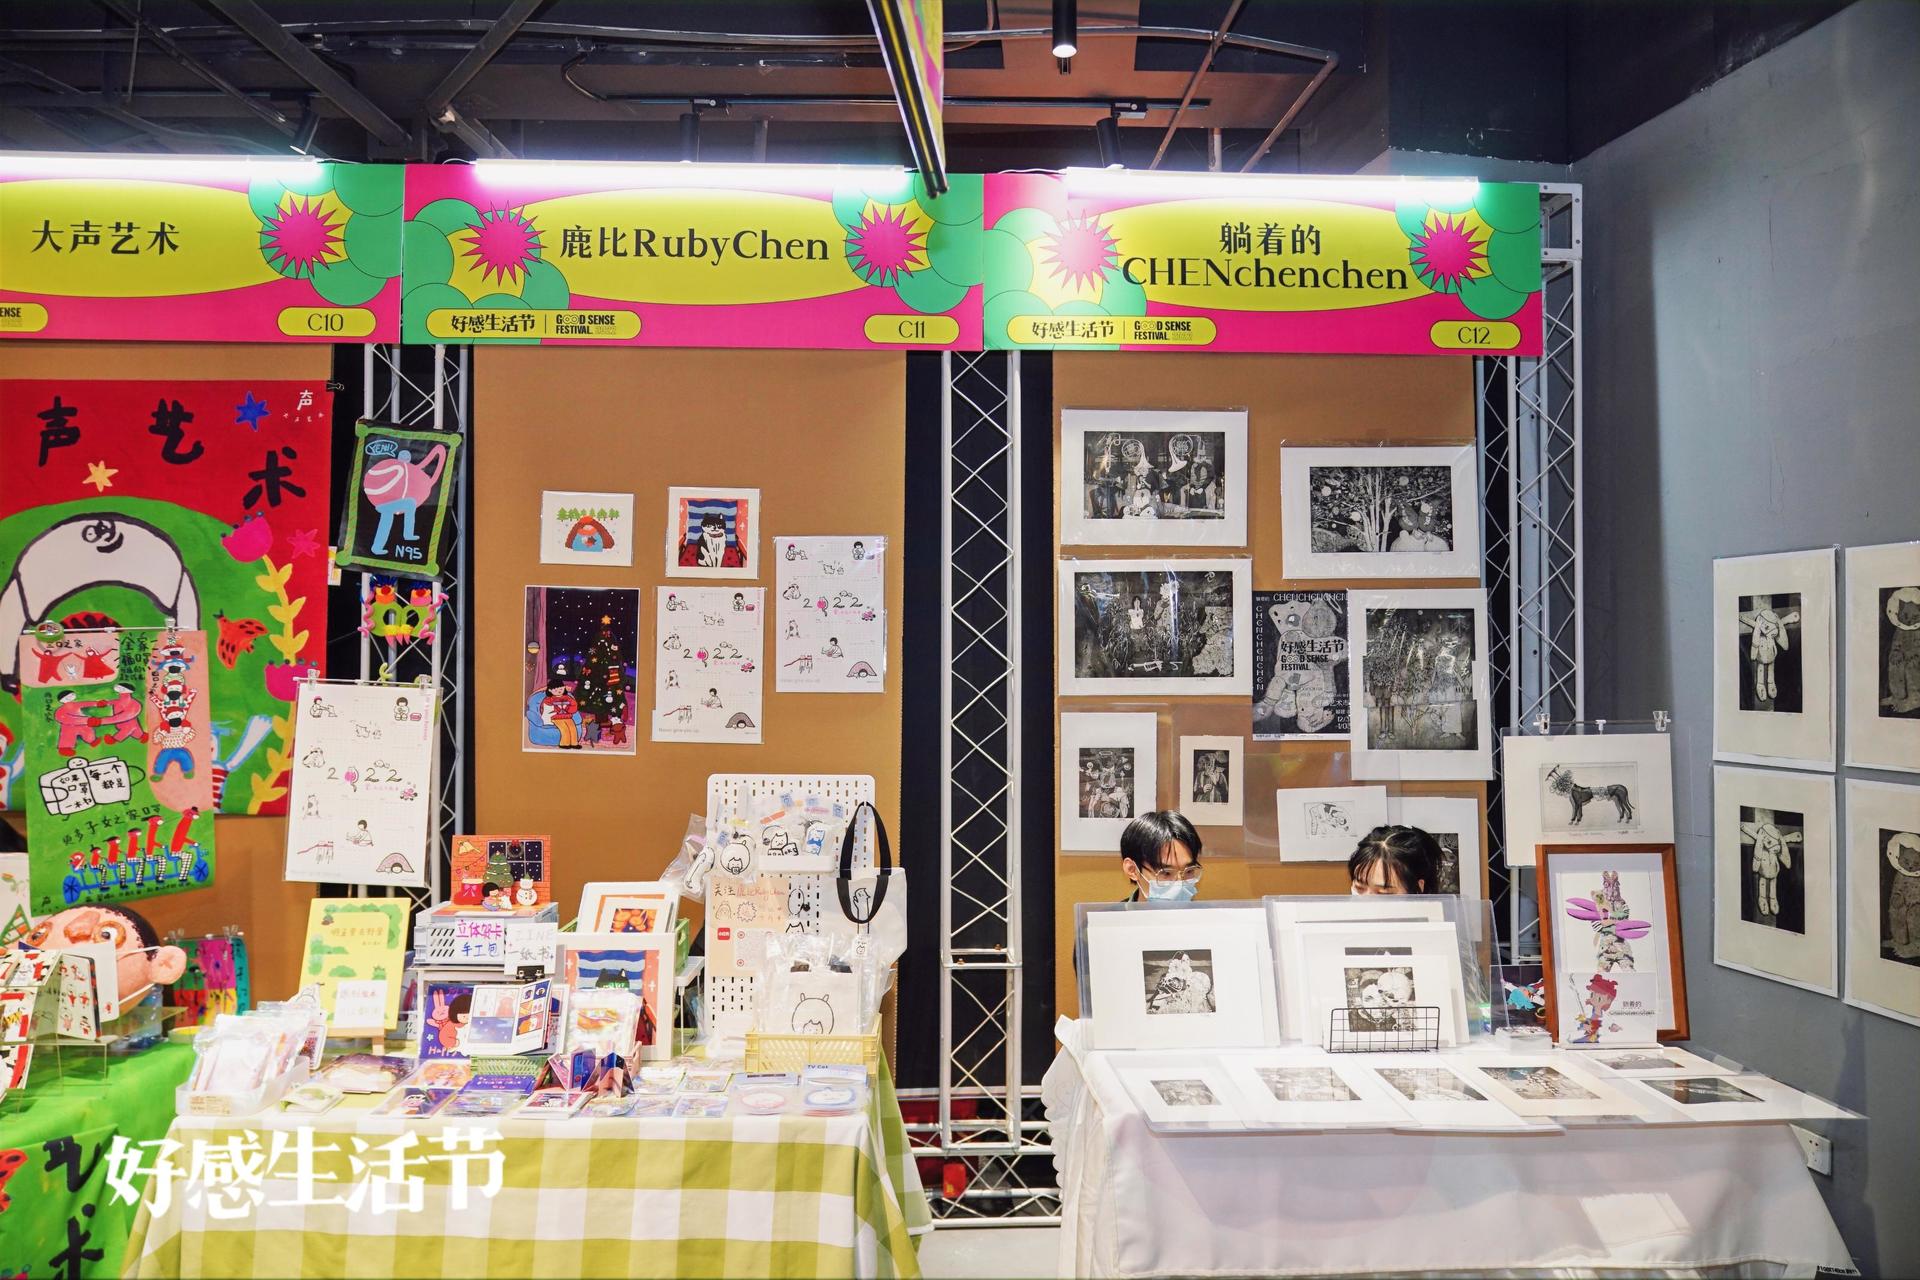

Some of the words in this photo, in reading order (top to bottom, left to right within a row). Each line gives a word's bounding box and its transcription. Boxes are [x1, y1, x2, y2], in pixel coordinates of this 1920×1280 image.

[31, 219, 180, 256] 大声艺术
[560, 225, 829, 266] 鹿比RubyChen
[1219, 222, 1321, 257] 躺着的
[1122, 257, 1409, 291] CHENchenchen
[307, 313, 344, 332] C10
[451, 313, 536, 334] 好感生活节
[556, 314, 586, 325] GOOD
[588, 315, 615, 325] SENSE
[1032, 319, 1114, 339] 好感生活节
[1134, 320, 1163, 331] GOOD
[1165, 321, 1191, 331] SENSE
[898, 320, 926, 339] C11
[1458, 325, 1491, 345] C12
[395, 544, 423, 560] N95
[1280, 639, 1345, 656] 好感生活节
[1306, 655, 1329, 663] SENSE
